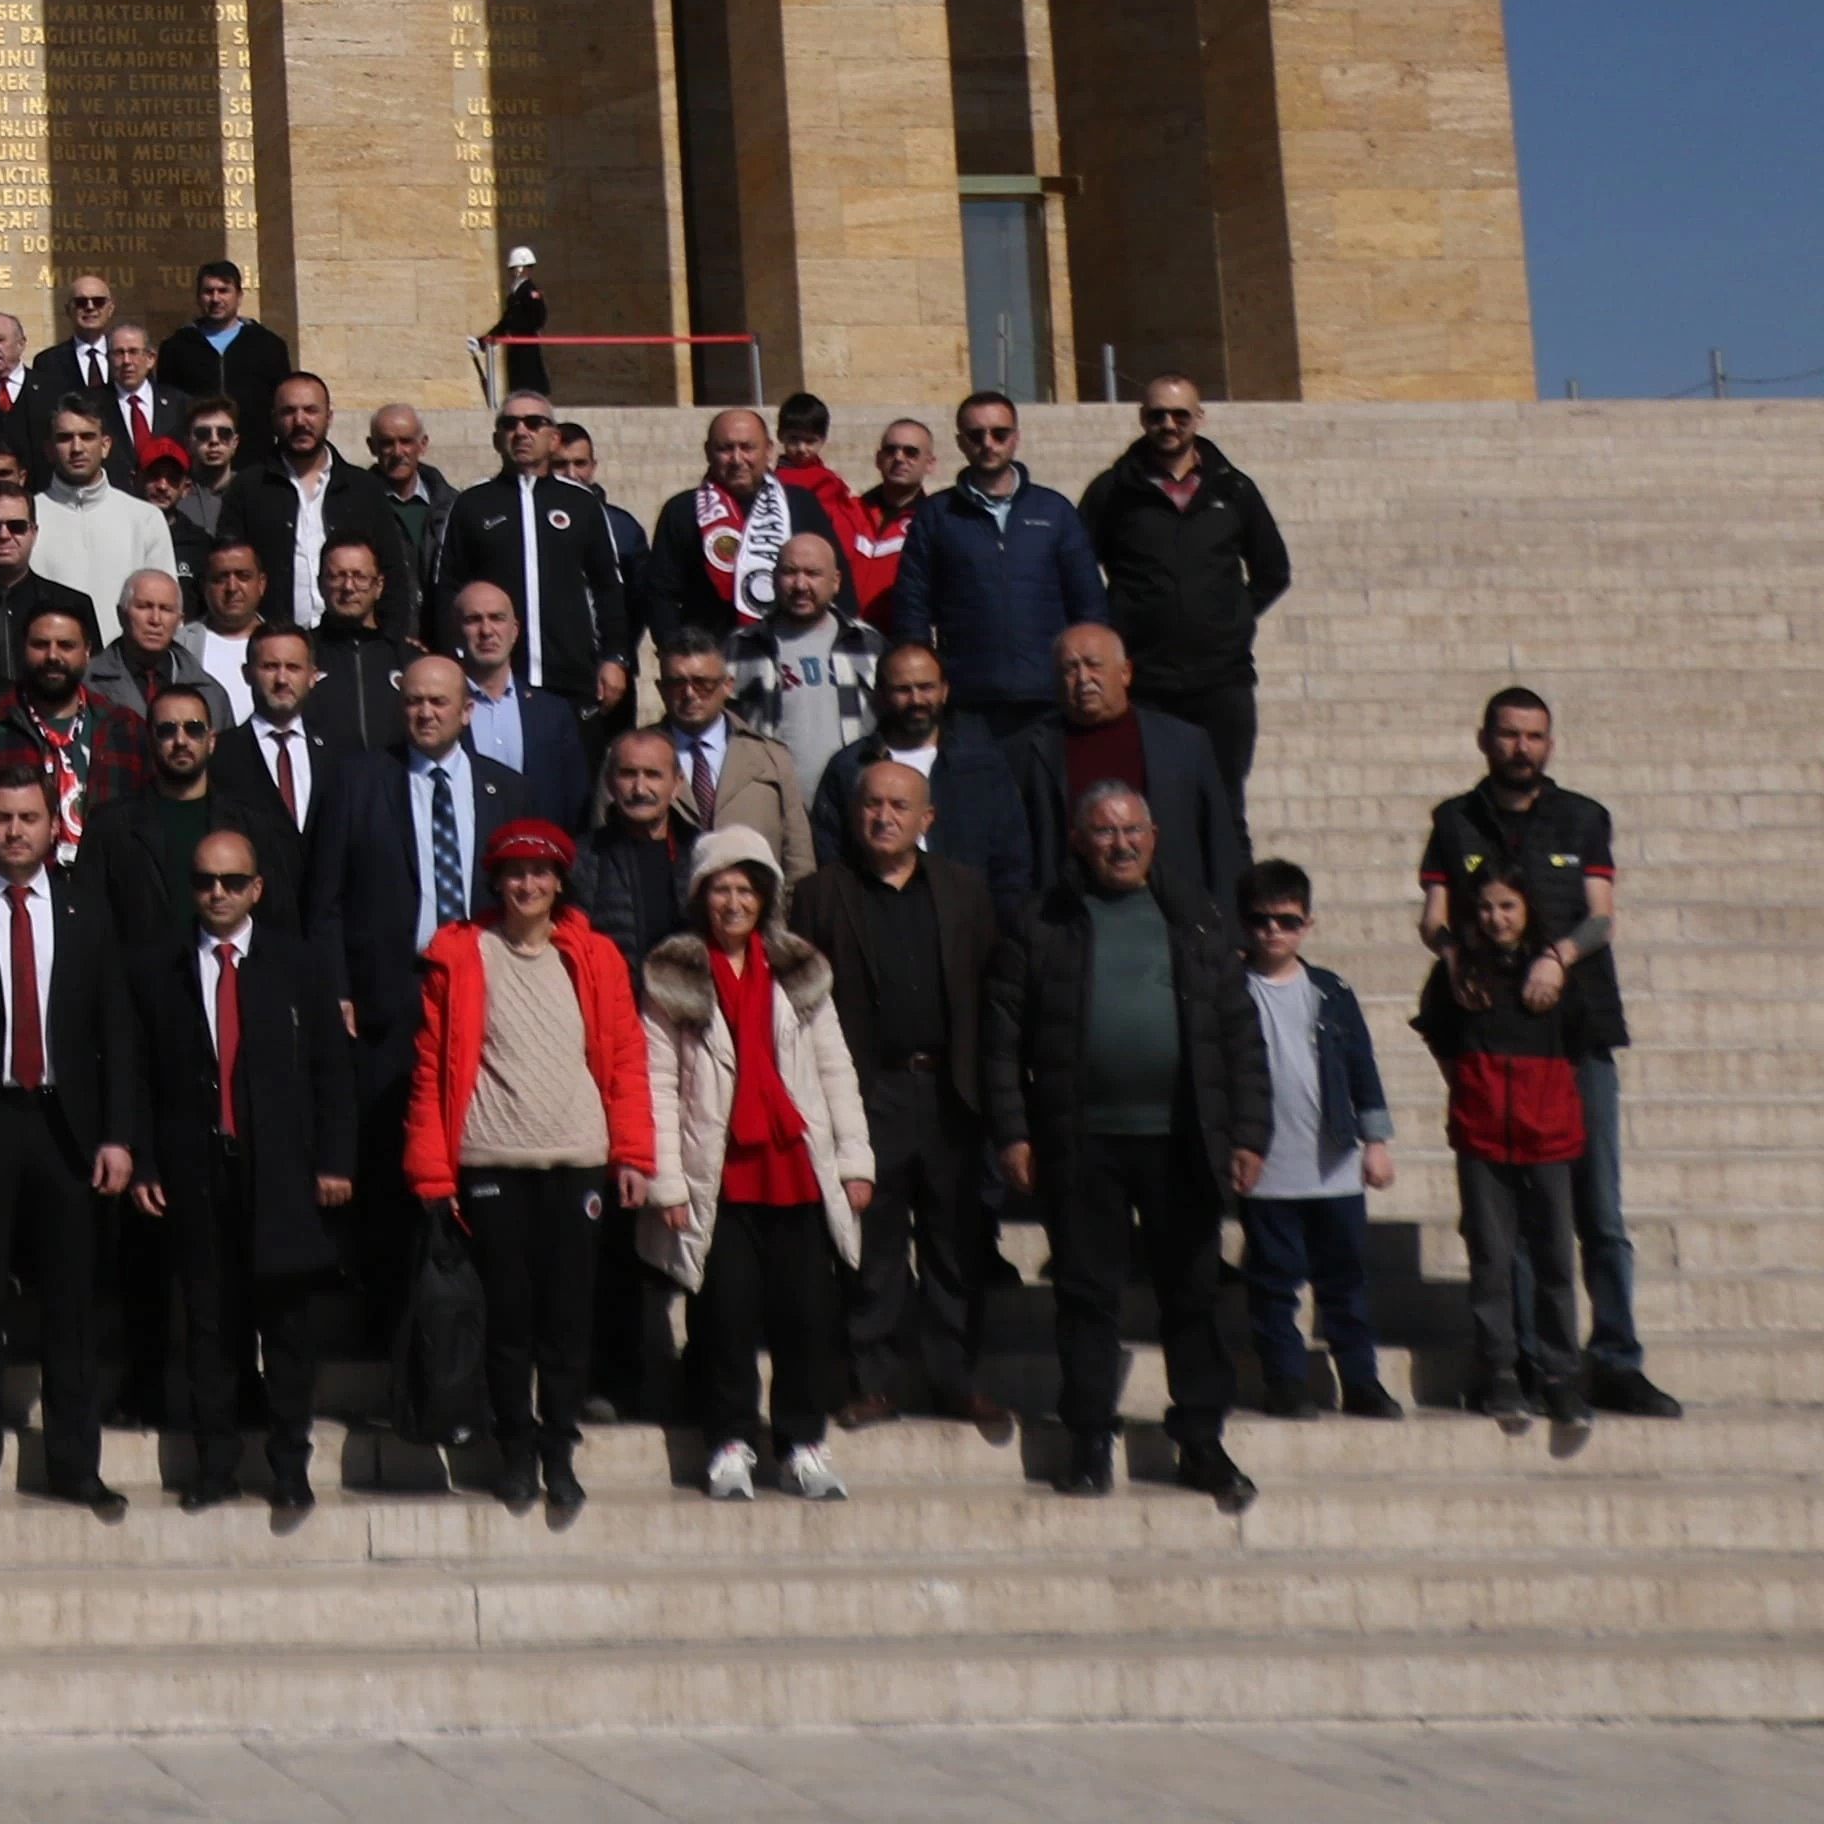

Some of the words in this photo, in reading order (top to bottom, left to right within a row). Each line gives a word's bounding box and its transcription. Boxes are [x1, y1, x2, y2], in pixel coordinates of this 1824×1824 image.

[81, 97, 106, 114] VE
[87, 120, 209, 138] YÜRÜMEKTE
[71, 166, 120, 184] ASLA
[141, 189, 164, 206] VE
